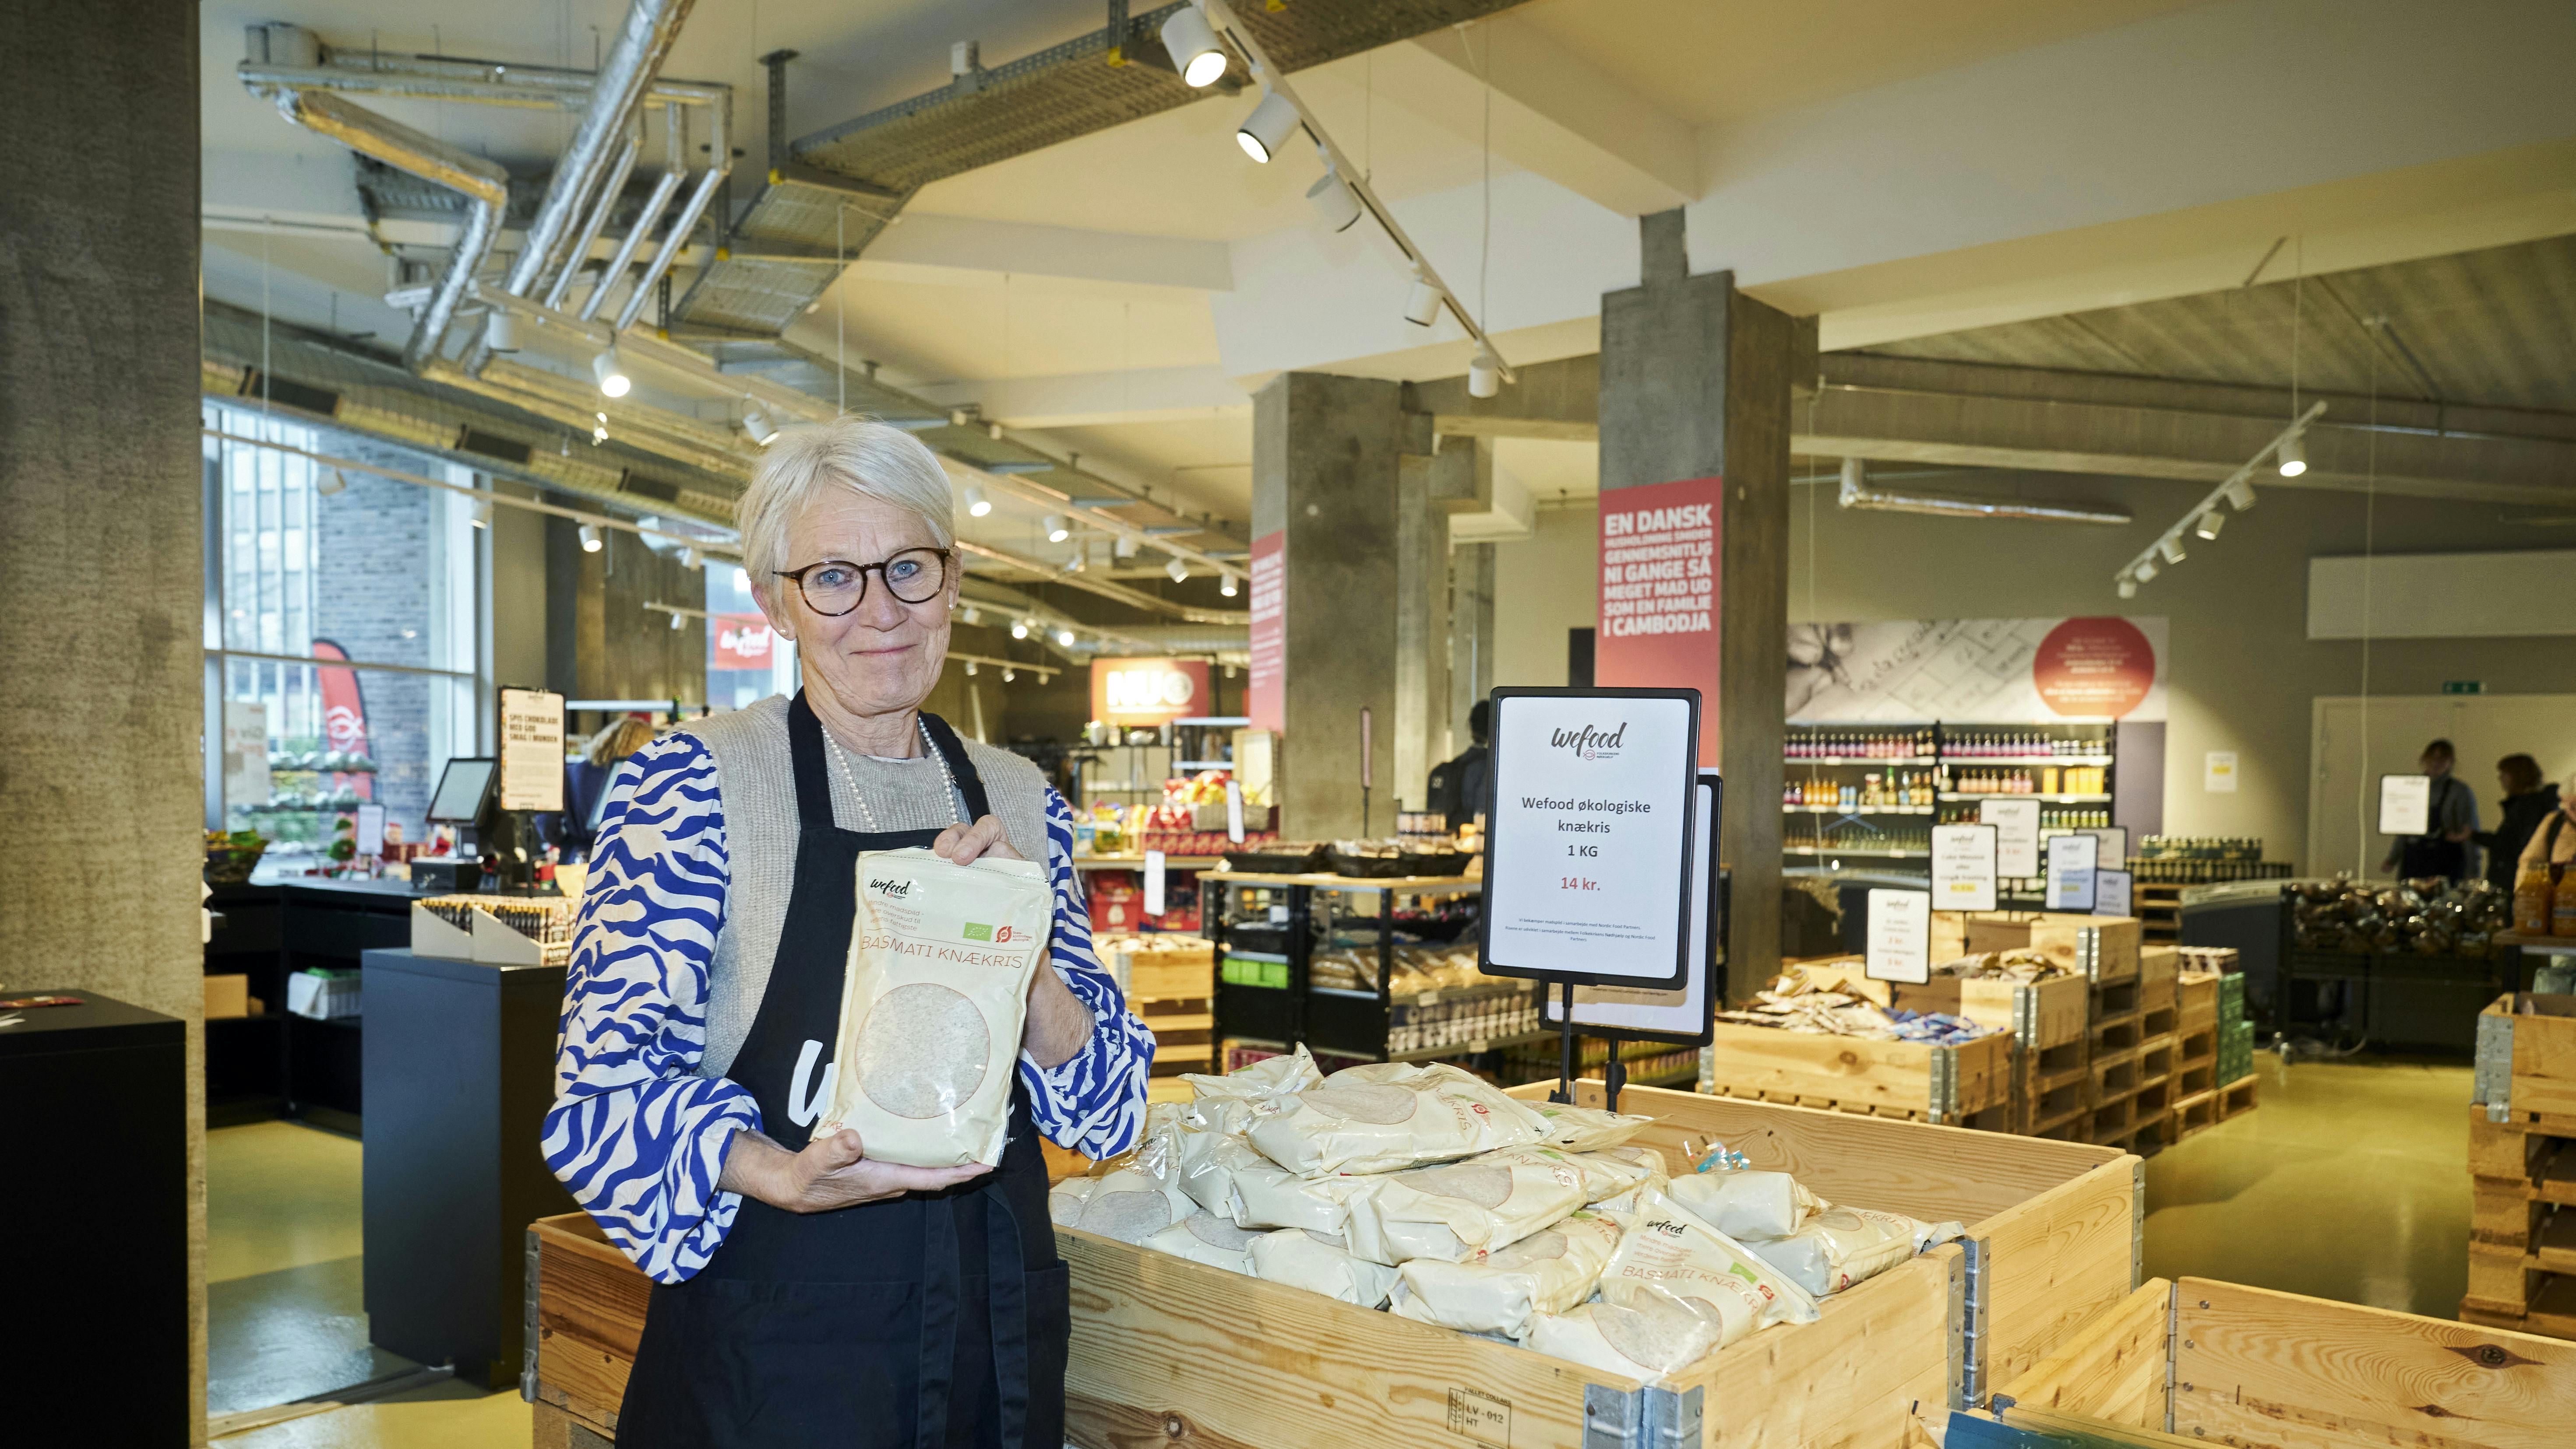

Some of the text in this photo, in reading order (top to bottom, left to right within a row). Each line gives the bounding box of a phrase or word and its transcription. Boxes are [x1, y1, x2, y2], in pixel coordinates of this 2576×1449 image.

[1605, 504, 1712, 536] EN DANSK
[1604, 555, 1712, 584] NI GANGE SÅ
[1604, 578, 1712, 600] MEGET MAD UD
[1604, 600, 1635, 617] SOM
[1636, 599, 1654, 615] EN
[1604, 611, 1711, 637] I CAMBODJA
[1551, 722, 1628, 757] wefood
[1522, 797, 1651, 815] Wefood økologiske
[1558, 820, 1610, 833] knækris
[1568, 845, 1598, 857] 1 KG
[870, 879, 911, 895] wefood
[1561, 877, 1600, 891] 14 kr.
[883, 910, 913, 922] overskud
[890, 905, 920, 916] madspild
[861, 935, 1023, 969] BASMATI KNÆKRIS
[1433, 1087, 1472, 1130] NÆKRIS
[1646, 1220, 1688, 1234] wefood
[1699, 1273, 1758, 1310] KNÆKR
[1465, 1386, 1512, 1405] PALLET COLLARS
[1466, 1417, 1479, 1427] HT
